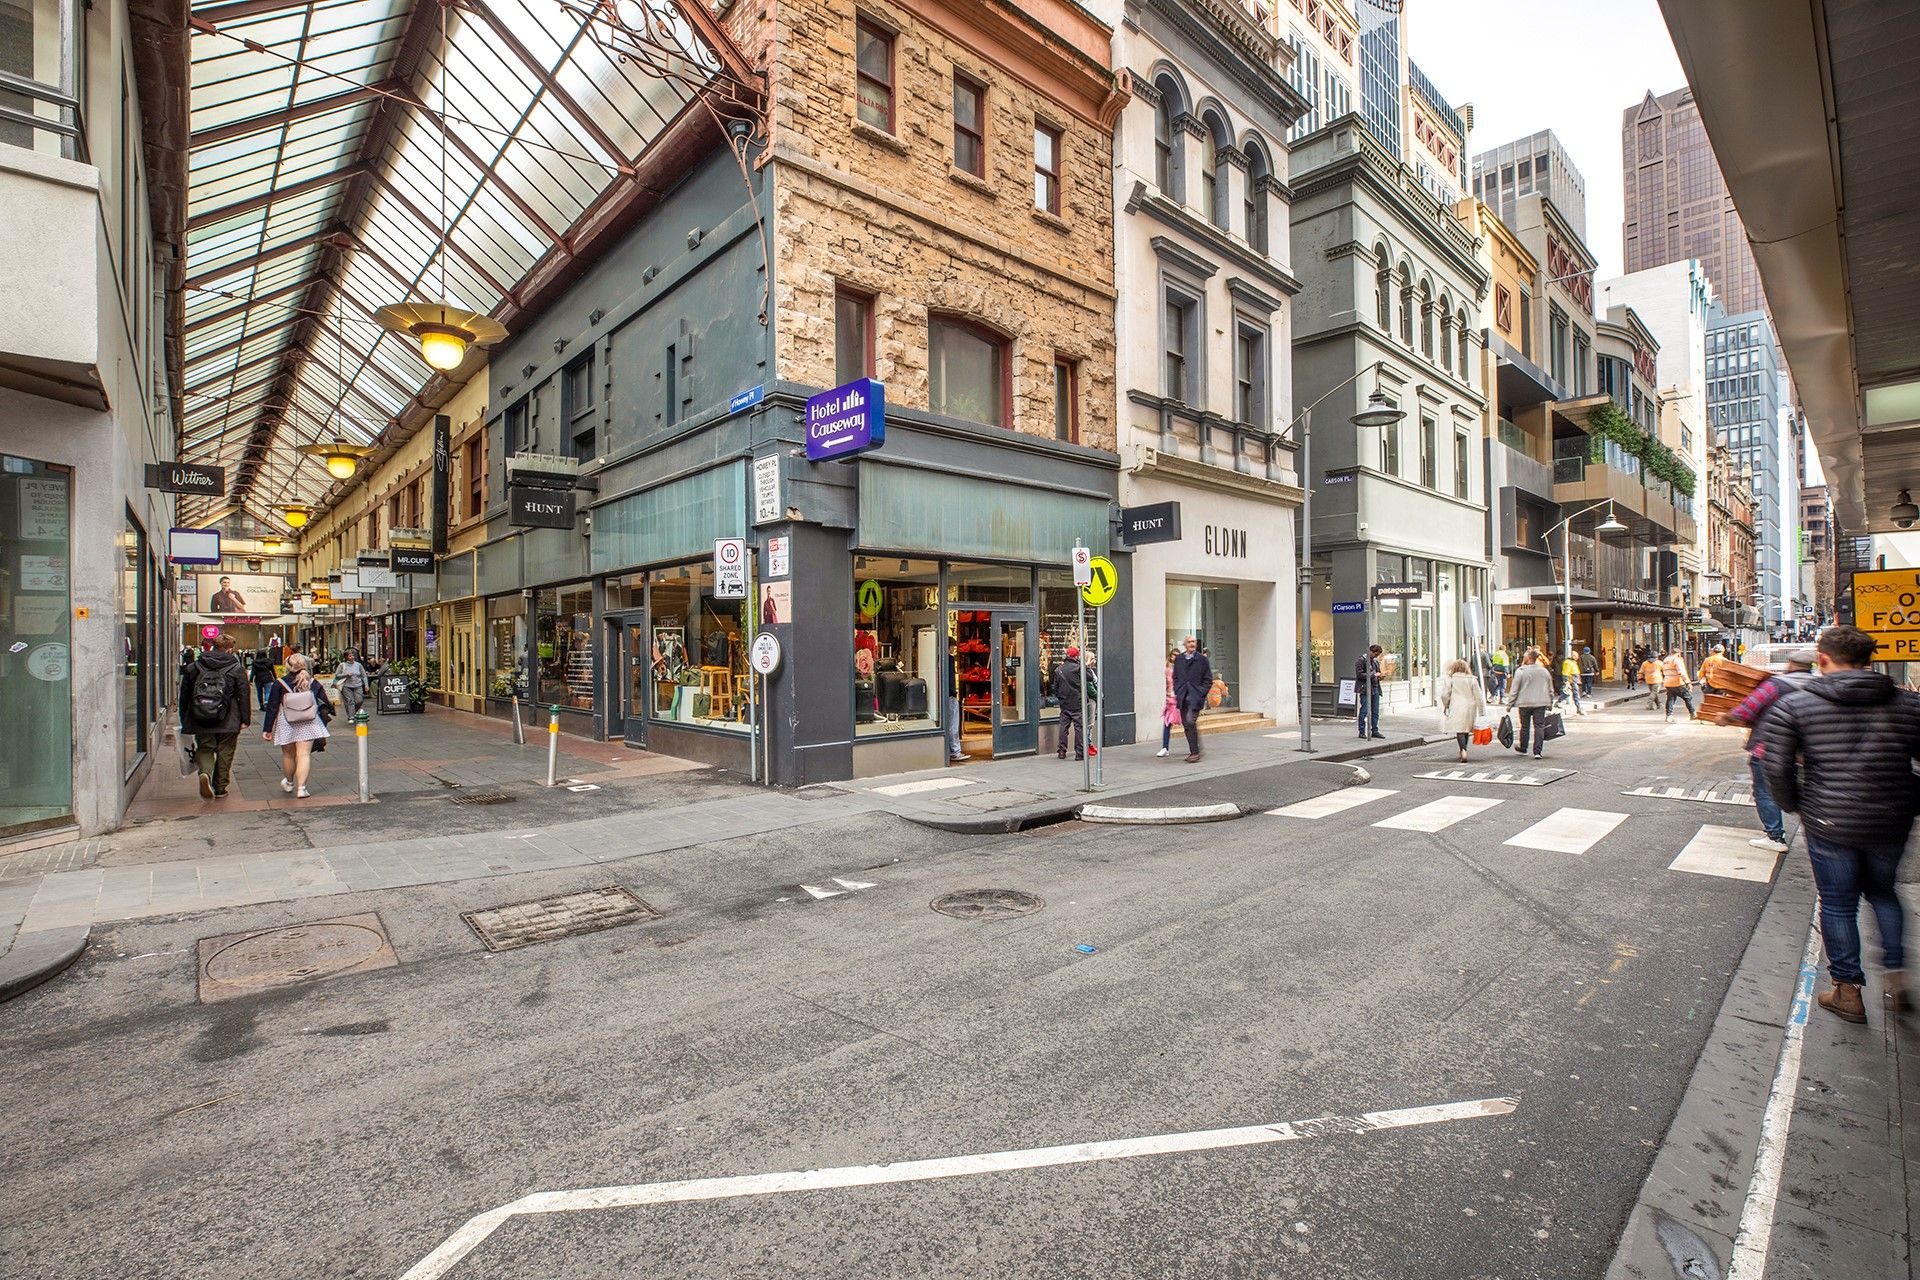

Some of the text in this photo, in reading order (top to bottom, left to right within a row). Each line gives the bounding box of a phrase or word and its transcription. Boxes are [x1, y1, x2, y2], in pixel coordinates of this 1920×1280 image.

[735, 391, 755, 407] Howey Pl
[812, 397, 840, 421] Hotel
[811, 413, 865, 438] Causeway
[172, 469, 214, 486] Wittner
[525, 502, 563, 515] HUNT
[1132, 518, 1164, 531] HUNT
[1205, 524, 1247, 559] GLDNN
[726, 548, 736, 558] 10
[1377, 586, 1418, 596] patagonia
[1899, 593, 1920, 607] O
[387, 678, 403, 686] MR.
[383, 685, 406, 693] CUFF
